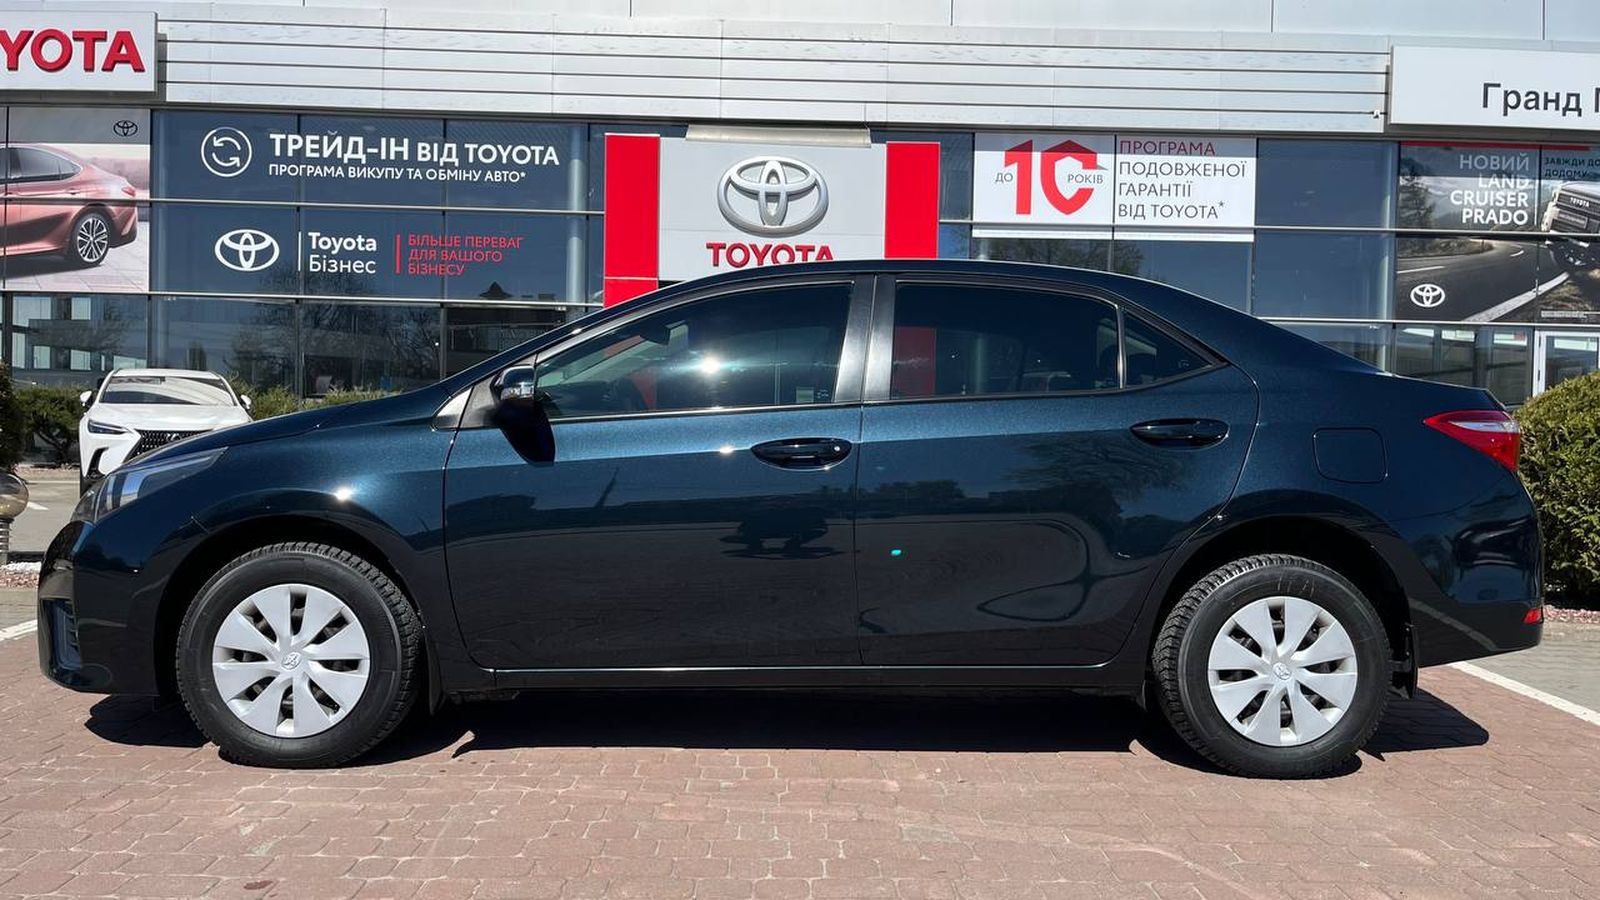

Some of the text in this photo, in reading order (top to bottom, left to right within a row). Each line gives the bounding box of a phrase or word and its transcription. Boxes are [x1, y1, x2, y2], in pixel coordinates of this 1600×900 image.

[1483, 83, 1582, 117] Гранд
[269, 130, 560, 167] ТРЕЙД-ІН ВІД TOYOTA
[1120, 140, 1215, 156] ПРОГРАМА
[1119, 160, 1248, 178] ПОДОВЖЕНОЇ
[1459, 152, 1529, 171] НОВИЙ
[269, 164, 344, 178] ПРОГРАМА
[348, 166, 404, 180] ВИКУПУ
[406, 168, 423, 180] ТА
[425, 168, 482, 181] ОБМІНУ
[995, 172, 1014, 184] ДО
[1067, 174, 1104, 184] РОКІВ
[1478, 172, 1530, 189] LAND
[1119, 180, 1193, 197] ГАРАНТІЇ
[1450, 189, 1529, 207] CRUISER
[1118, 204, 1146, 220] ВІД
[1462, 208, 1529, 226] PRADO
[308, 232, 377, 254] Toyota
[408, 234, 524, 249] БІЛЬШЕ ПЕРЕВАГ
[309, 254, 377, 274] Бізнес
[408, 249, 502, 262] ДЛЯ ВАШОГО
[706, 243, 834, 268] TOYOTA
[408, 264, 464, 275] БІЗНЕСУ
